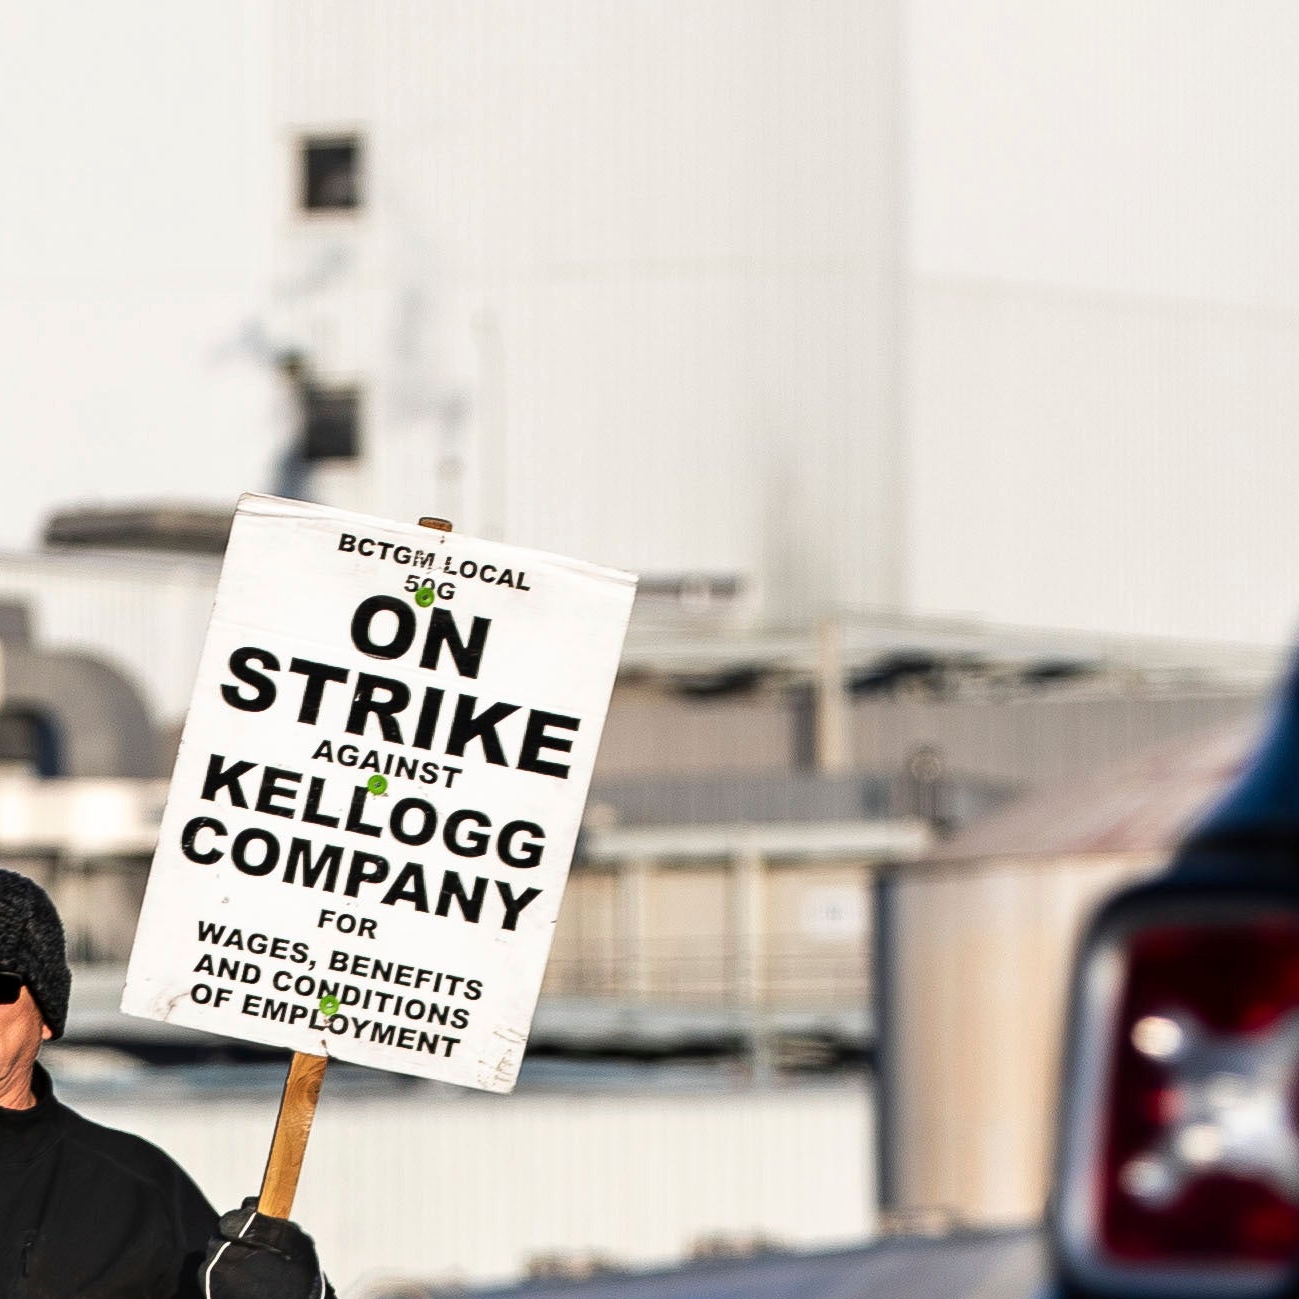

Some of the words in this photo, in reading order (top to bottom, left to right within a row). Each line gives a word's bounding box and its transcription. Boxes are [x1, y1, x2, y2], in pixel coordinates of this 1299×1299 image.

[337, 533, 436, 570] BCTGM
[443, 556, 531, 592] LOCAL
[350, 594, 492, 680] ON
[220, 646, 582, 780] STRIKE
[311, 739, 463, 789] AGAINST
[200, 753, 546, 869] KELLOGG
[180, 816, 543, 932] COMPANY
[198, 920, 317, 971] WAGES,
[328, 950, 483, 1001] BENEFITS
[317, 908, 378, 940] FOR
[190, 983, 233, 1008] OF
[241, 993, 461, 1058] EMPLOYMENT
[193, 953, 262, 985] AND
[272, 970, 470, 1030] CONDITIONS
